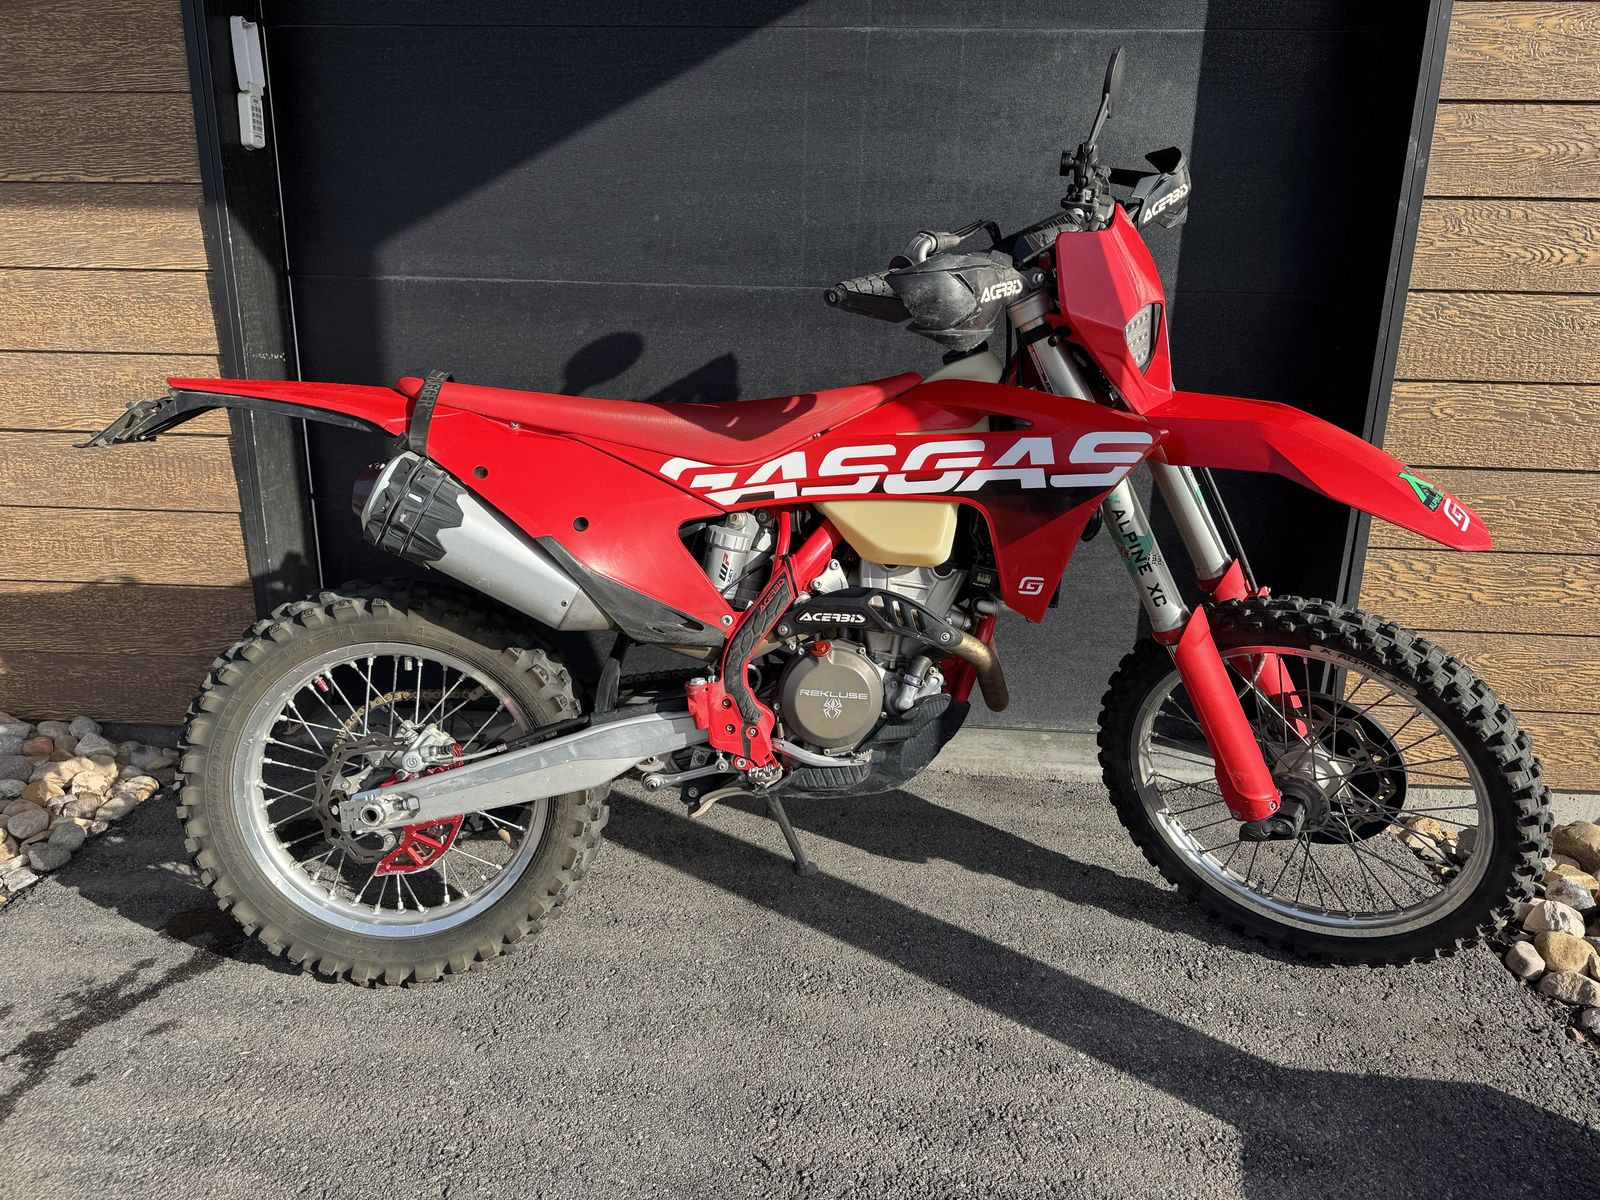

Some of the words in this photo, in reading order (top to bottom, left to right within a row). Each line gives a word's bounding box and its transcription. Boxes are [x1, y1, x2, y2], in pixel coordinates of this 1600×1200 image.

[659, 431, 1153, 505] GASGAS
[719, 552, 729, 582] WP
[1112, 510, 1153, 576] ALPINE
[1147, 582, 1167, 607] XC
[1337, 653, 1386, 677] ALPINE
[1391, 676, 1409, 690] XC
[800, 689, 868, 700] REKLUSE
